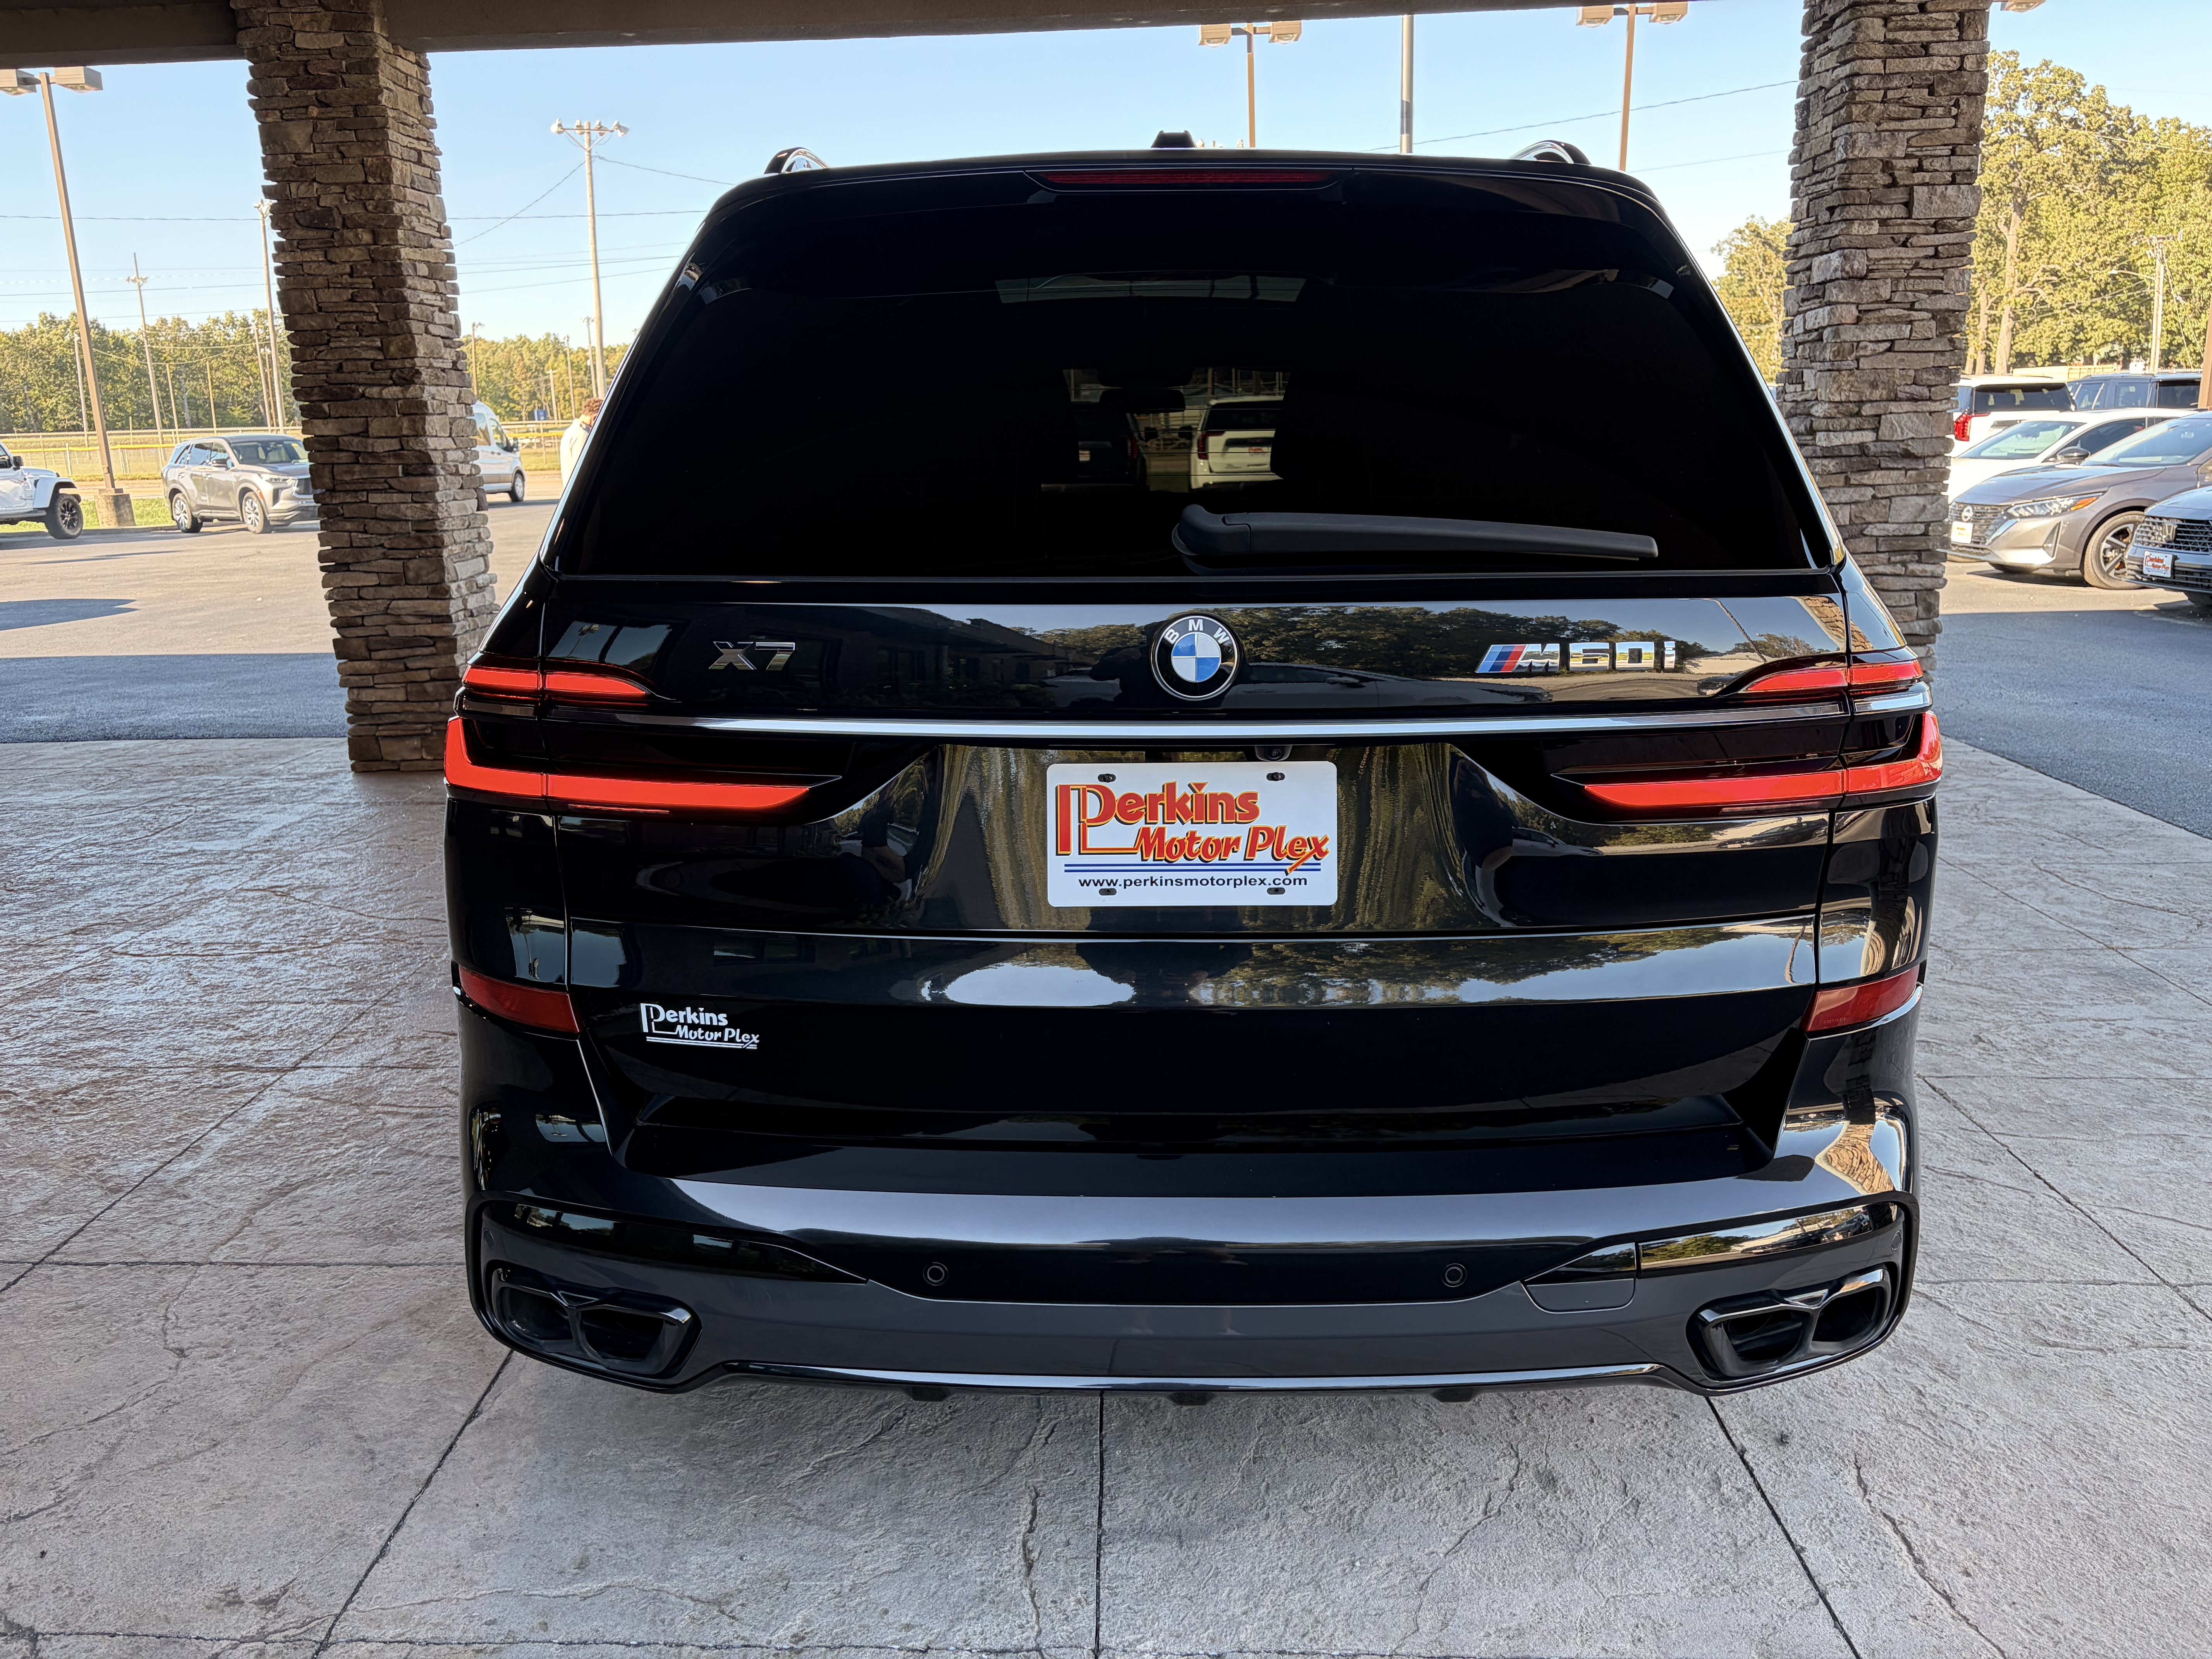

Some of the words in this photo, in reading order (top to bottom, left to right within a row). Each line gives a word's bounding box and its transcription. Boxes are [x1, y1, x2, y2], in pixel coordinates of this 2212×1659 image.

[1164, 619, 1230, 644] BMW
[709, 641, 796, 671] X7
[1056, 781, 1261, 856] Perkins
[1135, 826, 1242, 863] Motor
[1243, 825, 1330, 876] Plex
[1079, 875, 1307, 889] www.perkinsmotorplex.com
[640, 1003, 728, 1032] Perkins
[676, 1025, 722, 1041] Motor
[724, 1028, 760, 1048] Plex
